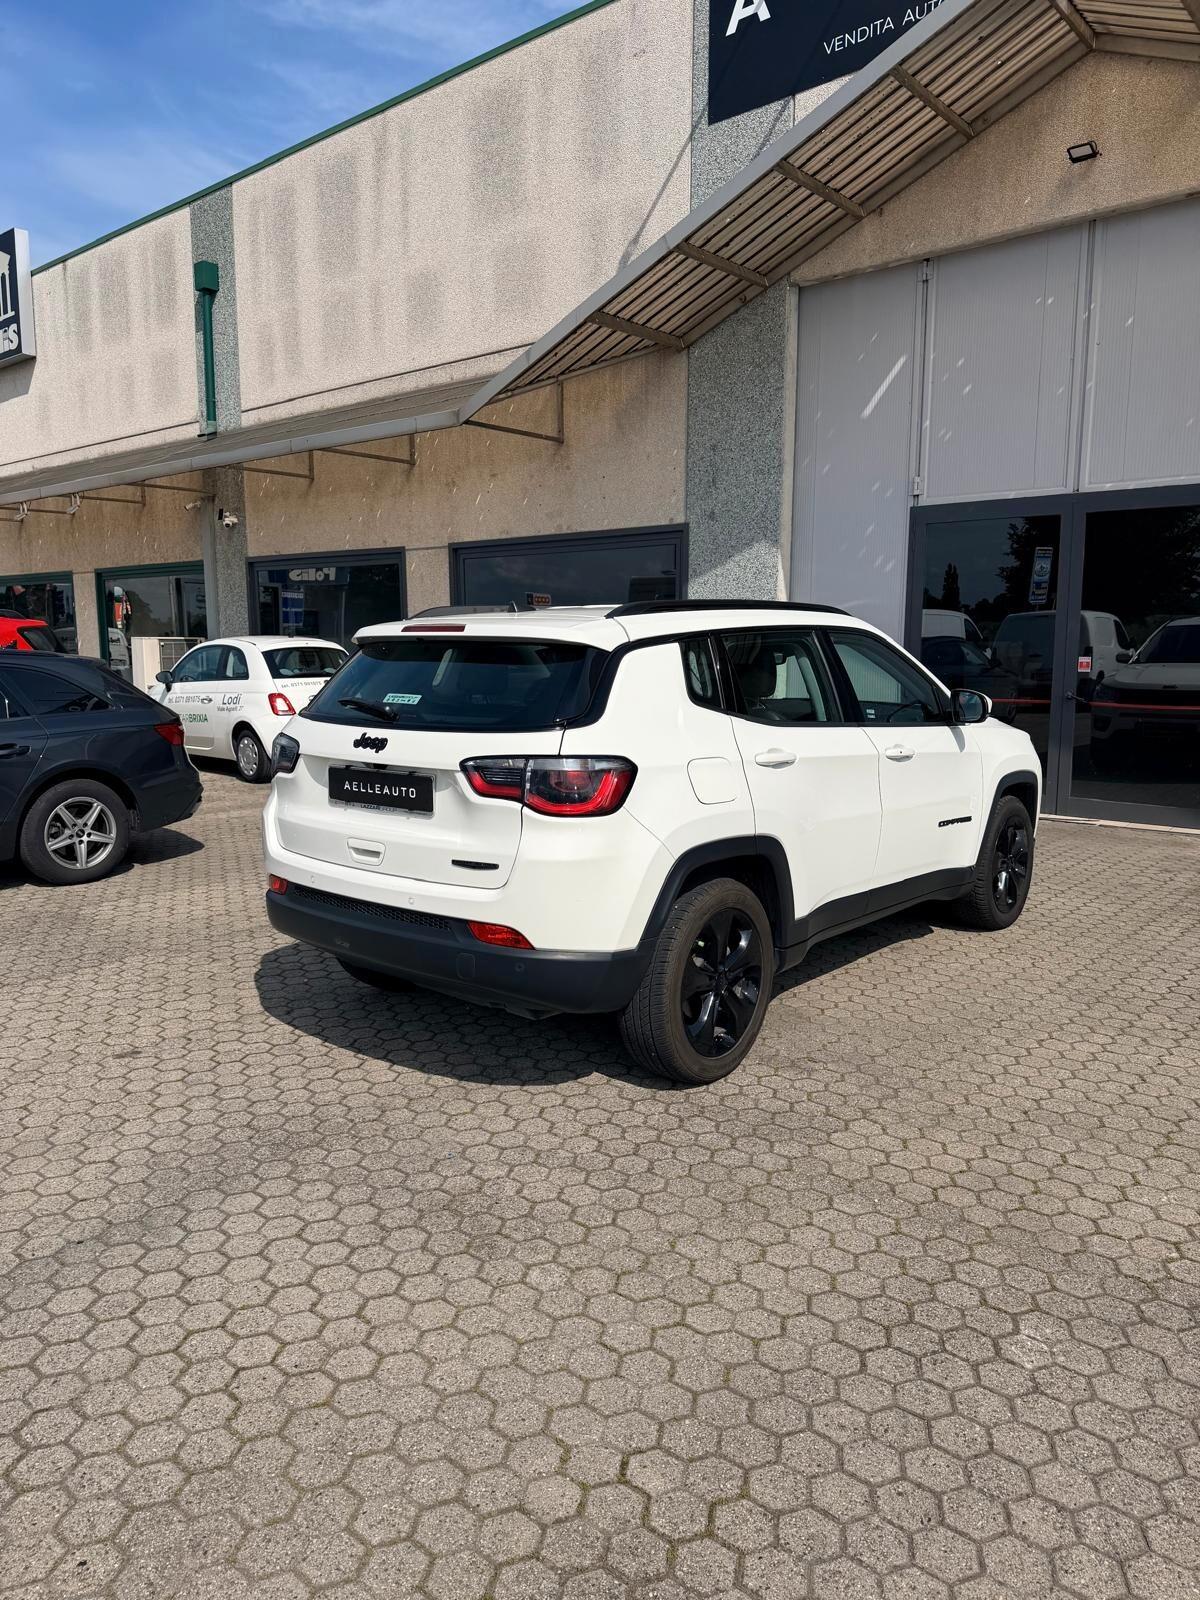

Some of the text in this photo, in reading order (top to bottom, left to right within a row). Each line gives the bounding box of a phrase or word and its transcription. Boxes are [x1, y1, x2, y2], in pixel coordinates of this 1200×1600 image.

[823, 0, 943, 55] VENDITA AUT
[221, 693, 243, 705] Lodi
[353, 732, 388, 754] Jeep
[343, 780, 417, 799] AELLEAUTO
